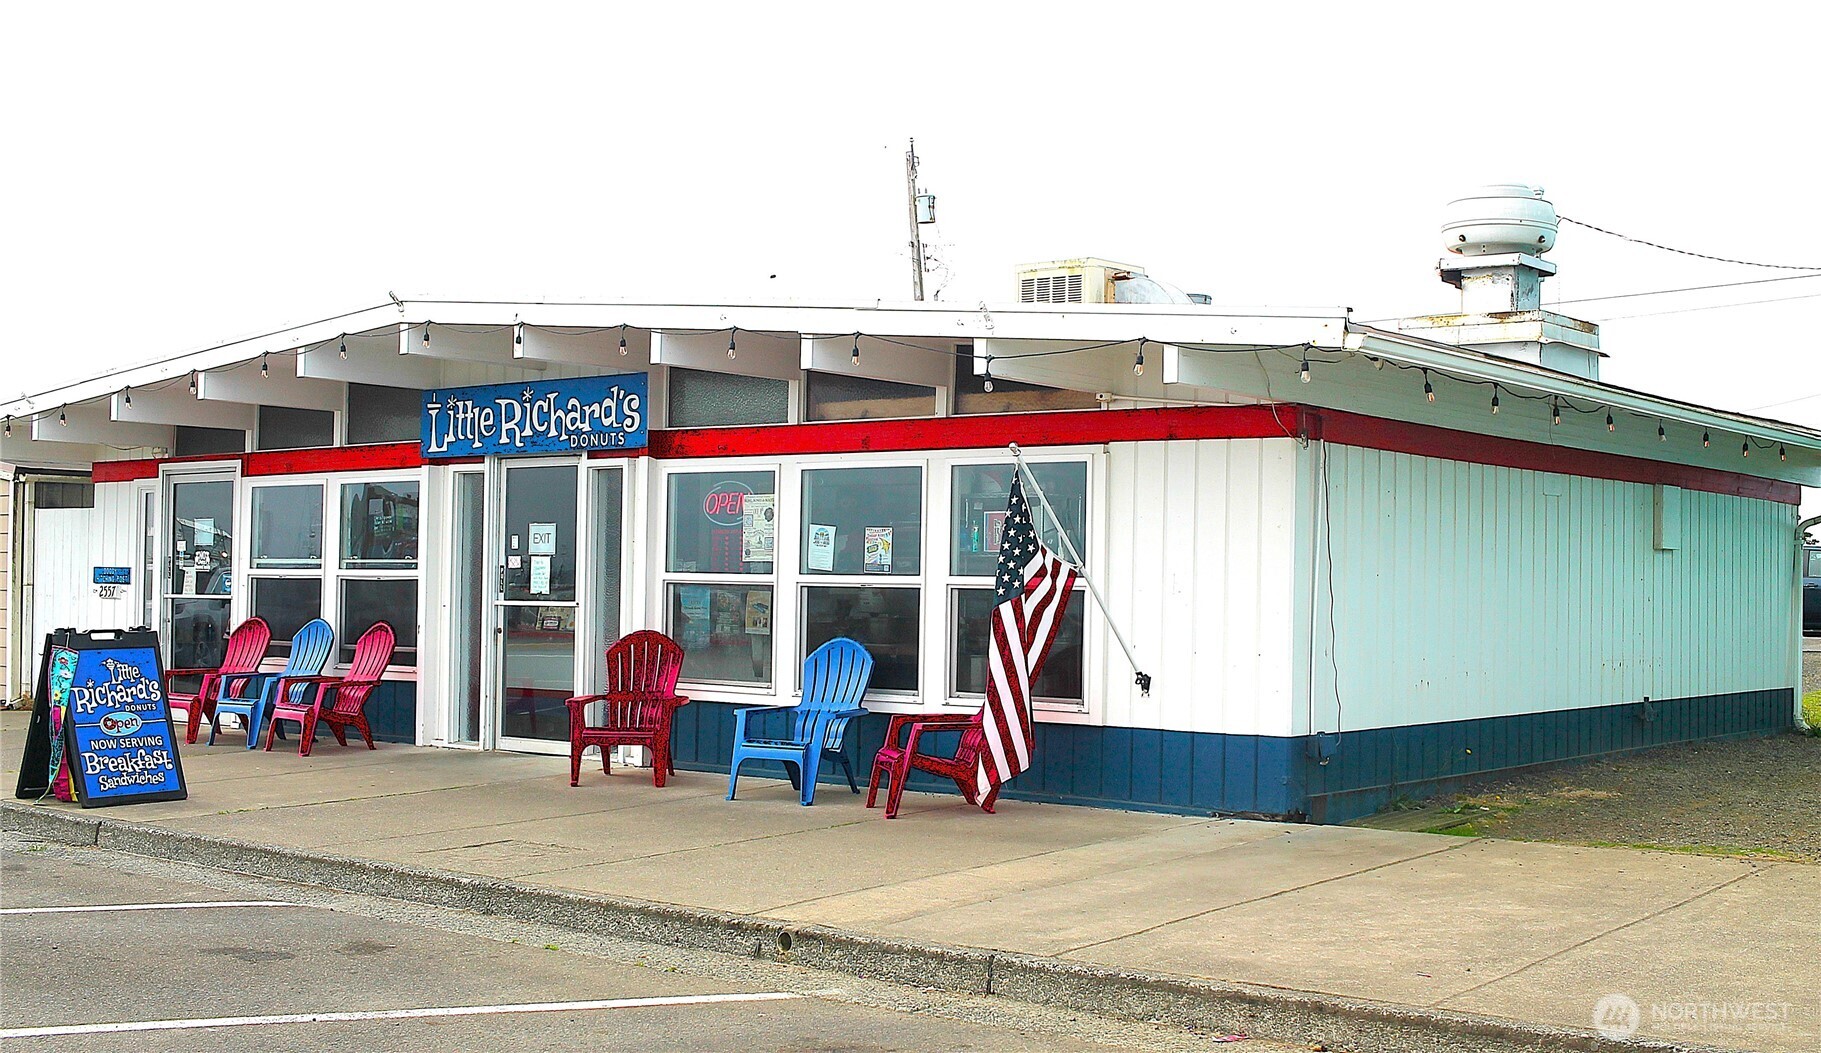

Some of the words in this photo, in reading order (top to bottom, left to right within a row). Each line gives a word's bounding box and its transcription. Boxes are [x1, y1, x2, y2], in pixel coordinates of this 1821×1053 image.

[427, 392, 496, 453] Little
[495, 385, 641, 447] Richard's
[570, 432, 625, 448] DONUTS
[533, 532, 552, 544] EXIT
[105, 659, 140, 685] Little
[70, 677, 161, 714] Richard's
[125, 703, 157, 712] DONUTS
[102, 716, 140, 733] Open
[90, 739, 119, 750] NOW
[120, 736, 163, 748] SERVING
[81, 749, 174, 775] Breakfast
[99, 770, 165, 791] Sandwiches
